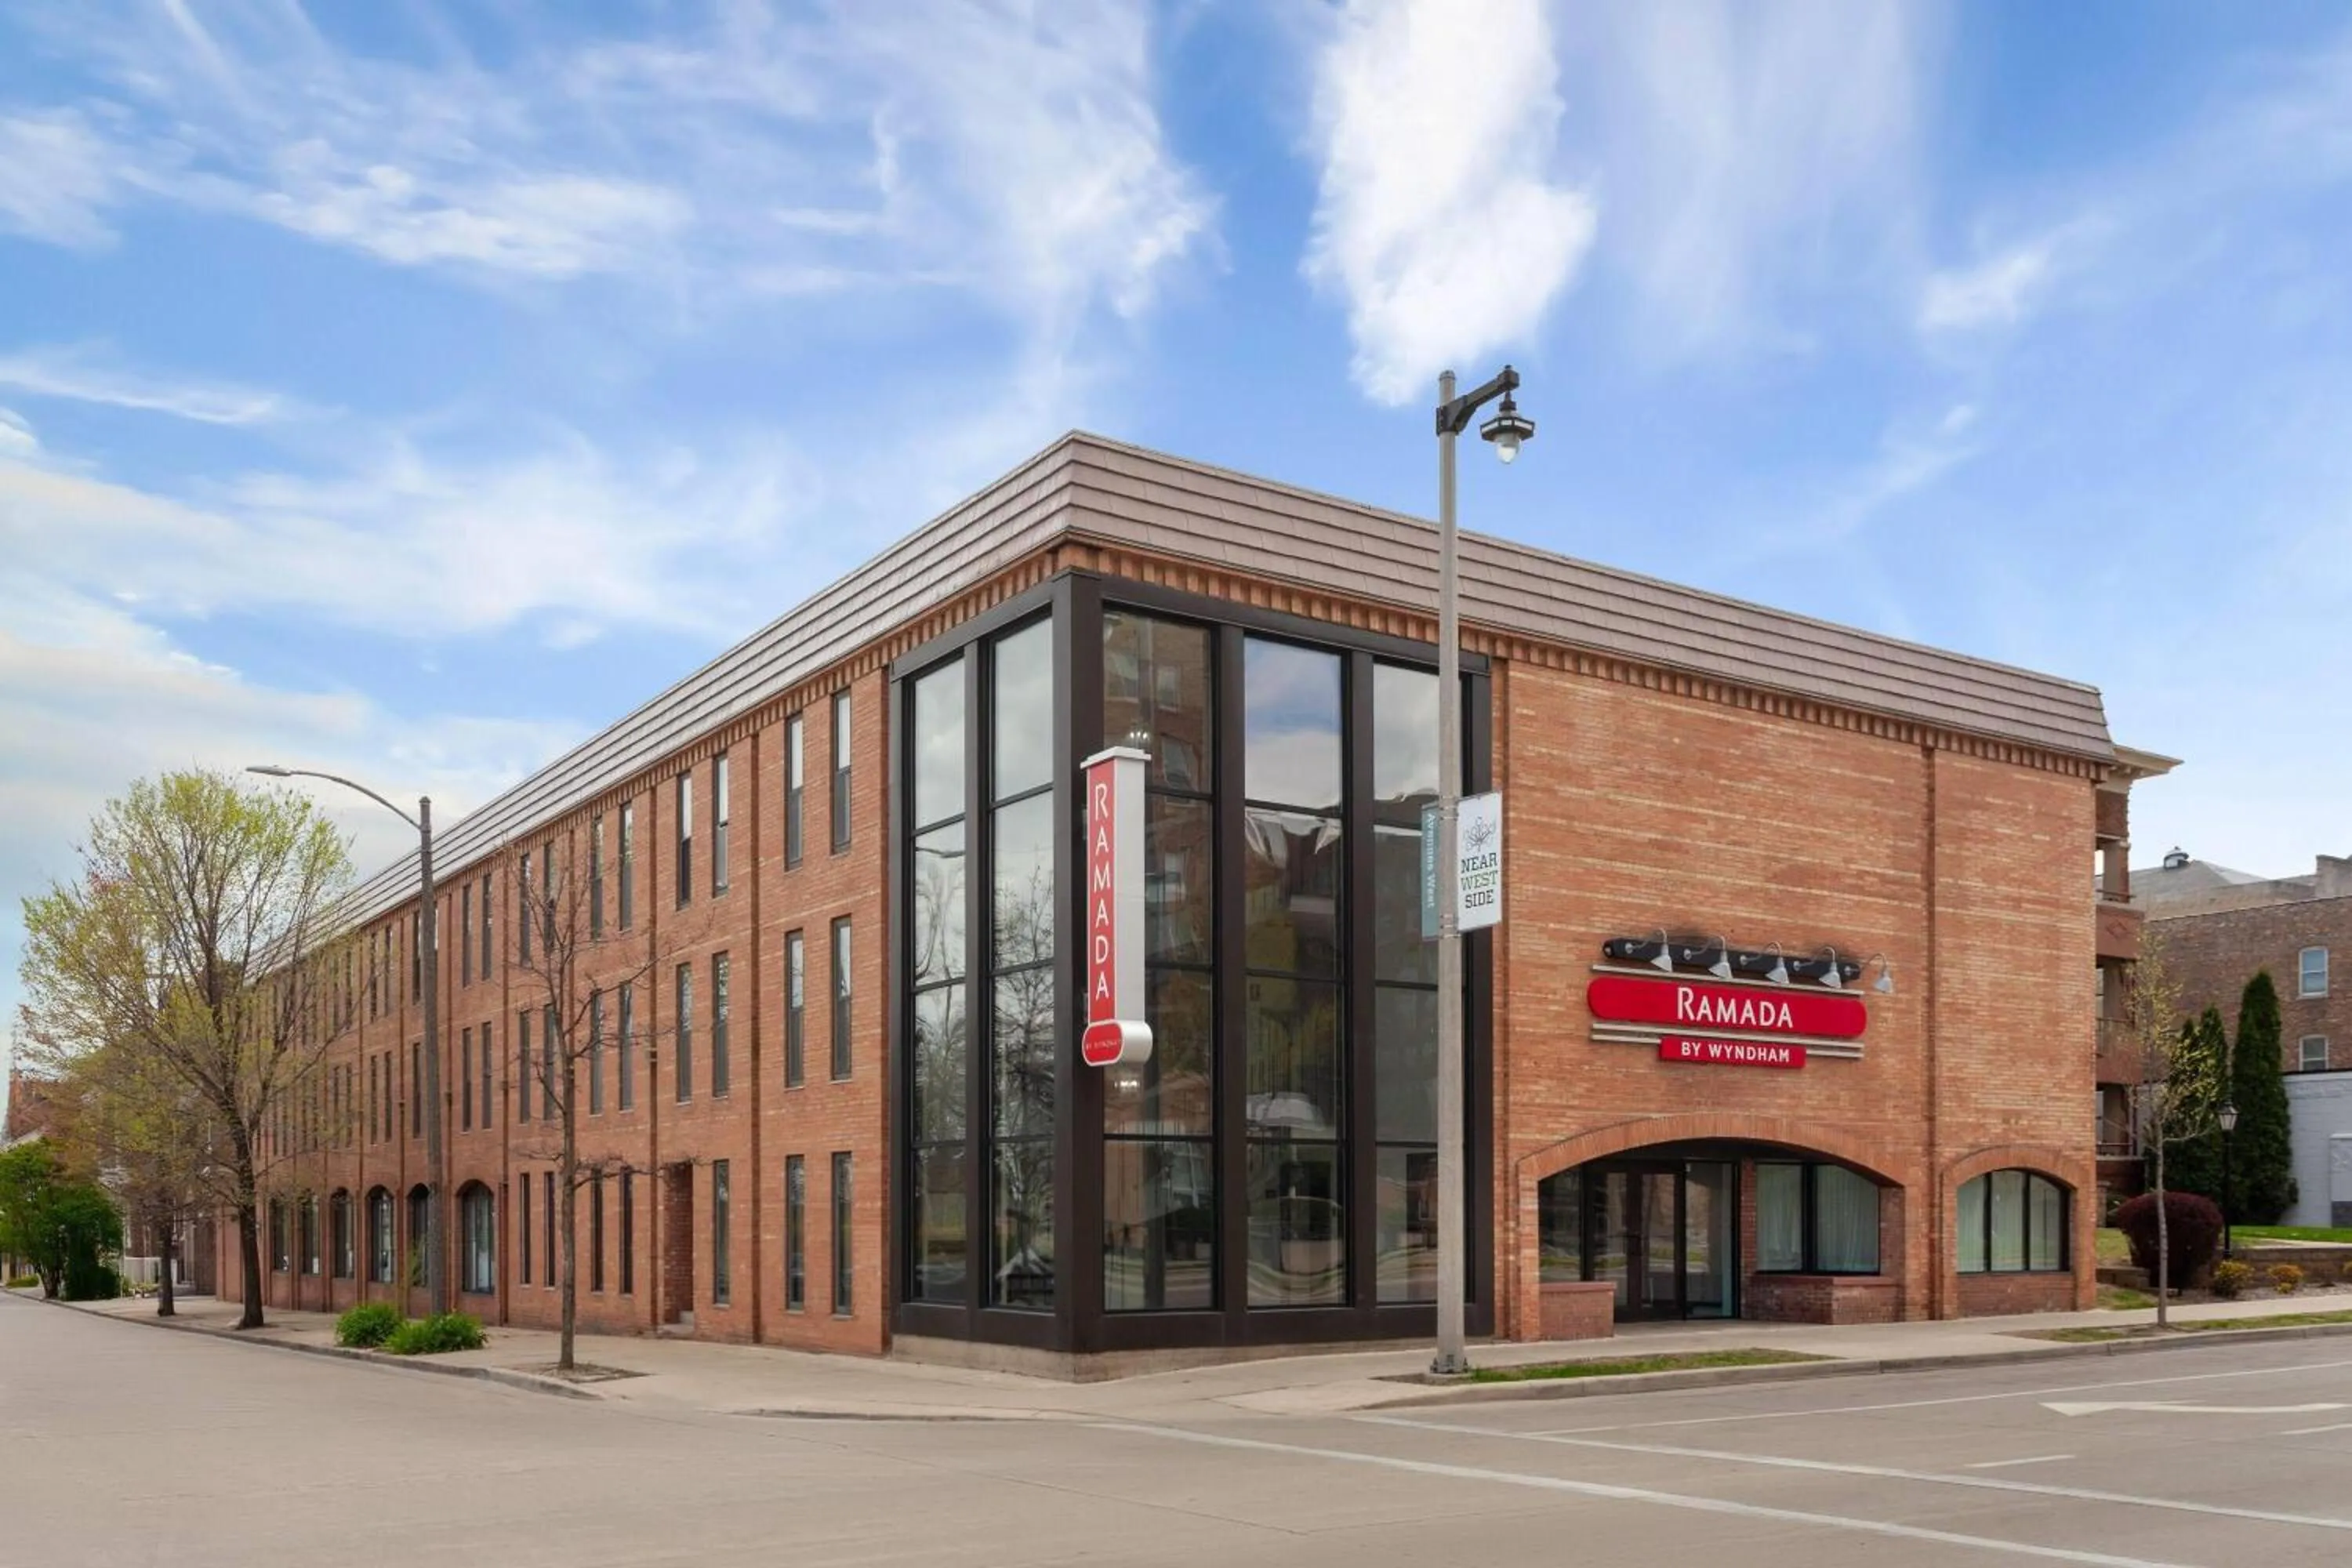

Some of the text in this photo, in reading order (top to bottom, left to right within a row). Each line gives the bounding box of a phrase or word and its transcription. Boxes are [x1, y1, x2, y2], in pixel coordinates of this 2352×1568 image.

[1461, 852, 1497, 873] NEAR
[1461, 870, 1497, 891] WEST
[1093, 783, 1111, 1000] RAMADA
[1465, 890, 1494, 909] SIDE
[1677, 986, 1794, 1029] RAMADA
[1681, 1041, 1790, 1062] BY WYNDHAM
